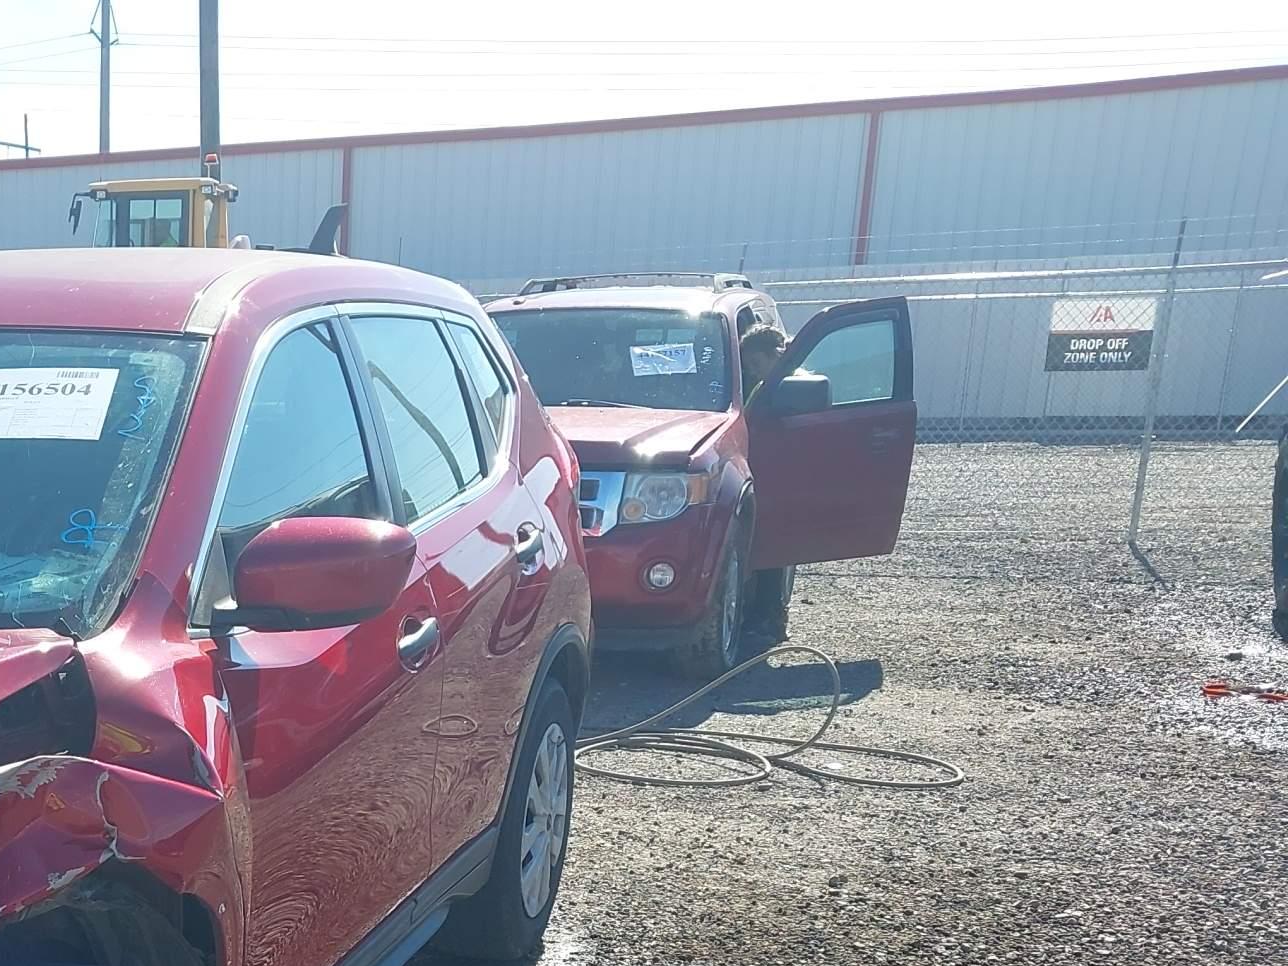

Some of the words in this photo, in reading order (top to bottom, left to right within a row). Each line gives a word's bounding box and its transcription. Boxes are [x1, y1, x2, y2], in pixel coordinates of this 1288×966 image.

[1070, 338, 1104, 350] DROP
[1107, 337, 1129, 350] OFF
[1063, 352, 1097, 364] ZONE
[1099, 351, 1132, 363] ONLY
